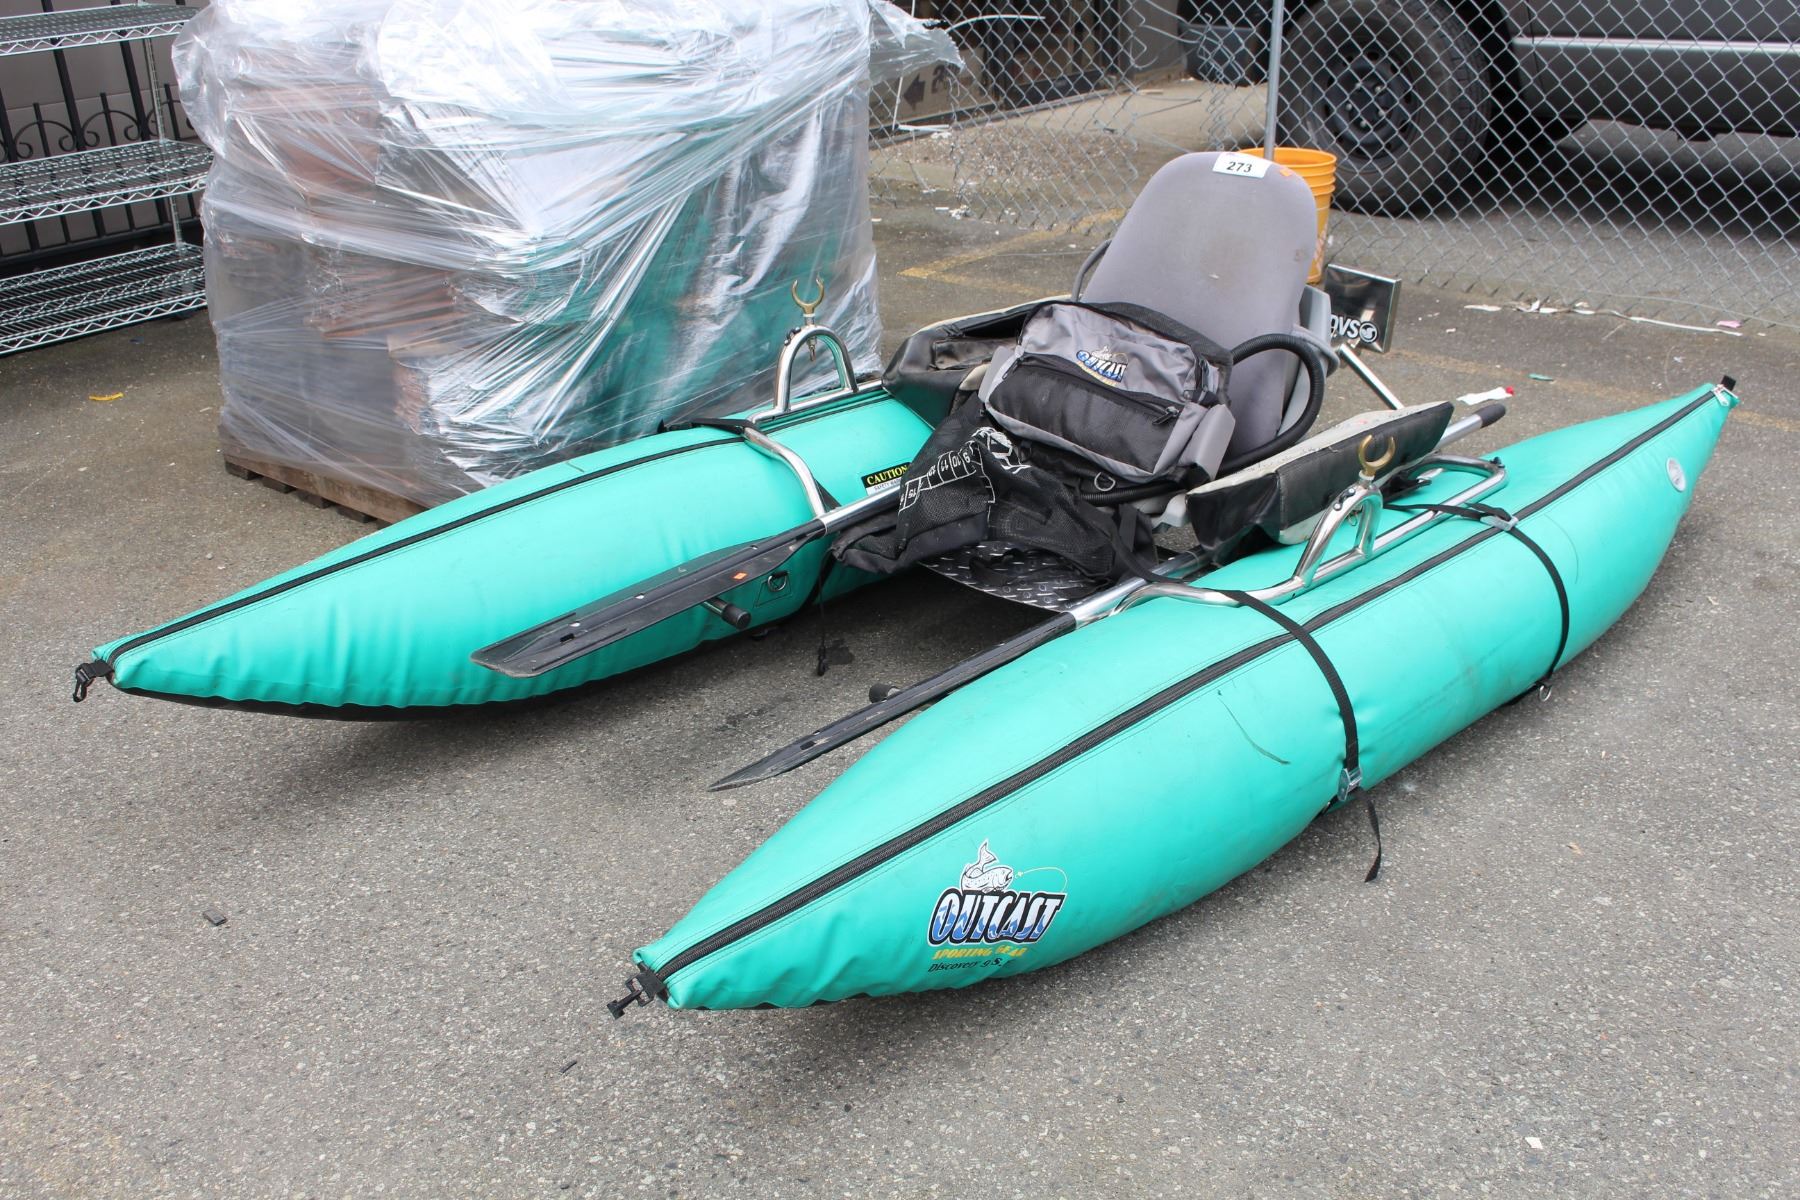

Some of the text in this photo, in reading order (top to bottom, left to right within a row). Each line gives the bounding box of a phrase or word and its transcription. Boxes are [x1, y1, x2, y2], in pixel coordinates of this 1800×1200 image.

[1226, 160, 1253, 173] 273
[866, 464, 908, 486] CAUTION
[927, 887, 1067, 945] OUTCAST
[932, 947, 993, 960] SPORTING
